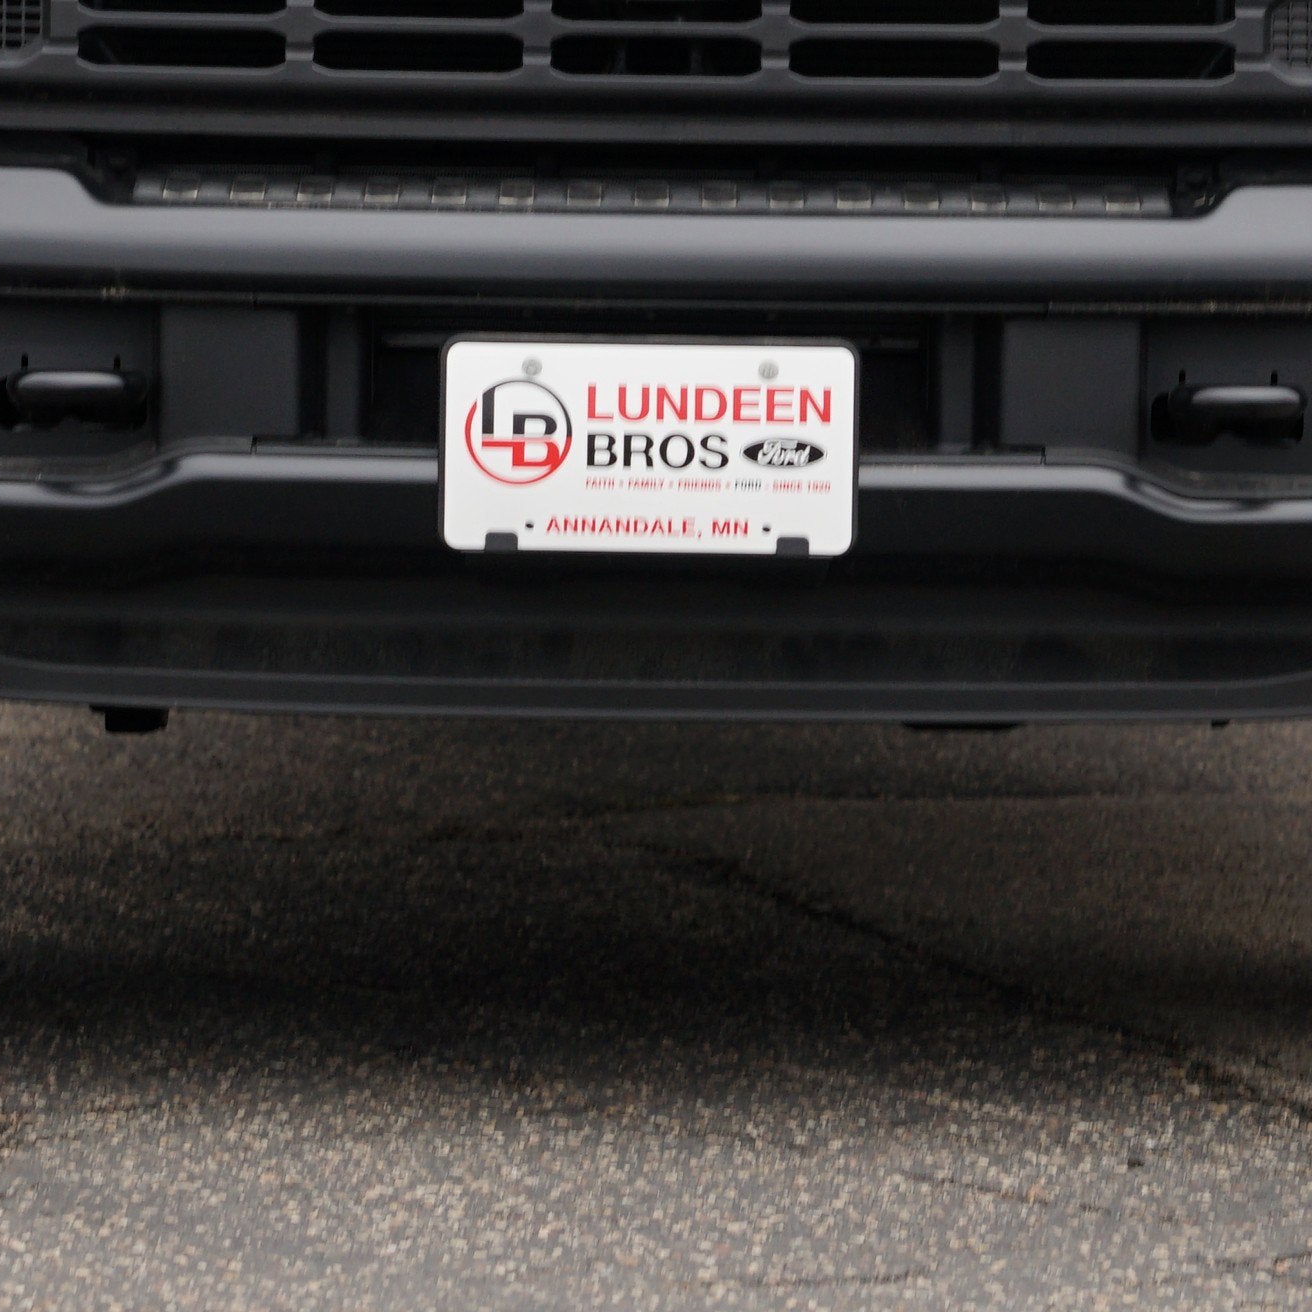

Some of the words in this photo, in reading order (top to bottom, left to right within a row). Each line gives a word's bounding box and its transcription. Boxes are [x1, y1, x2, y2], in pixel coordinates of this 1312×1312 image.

[587, 383, 832, 425] LUNDEEN
[586, 433, 730, 469] BROS
[756, 439, 812, 467] Ford
[545, 515, 703, 539] ANNANDALE,
[711, 517, 750, 537] MN
